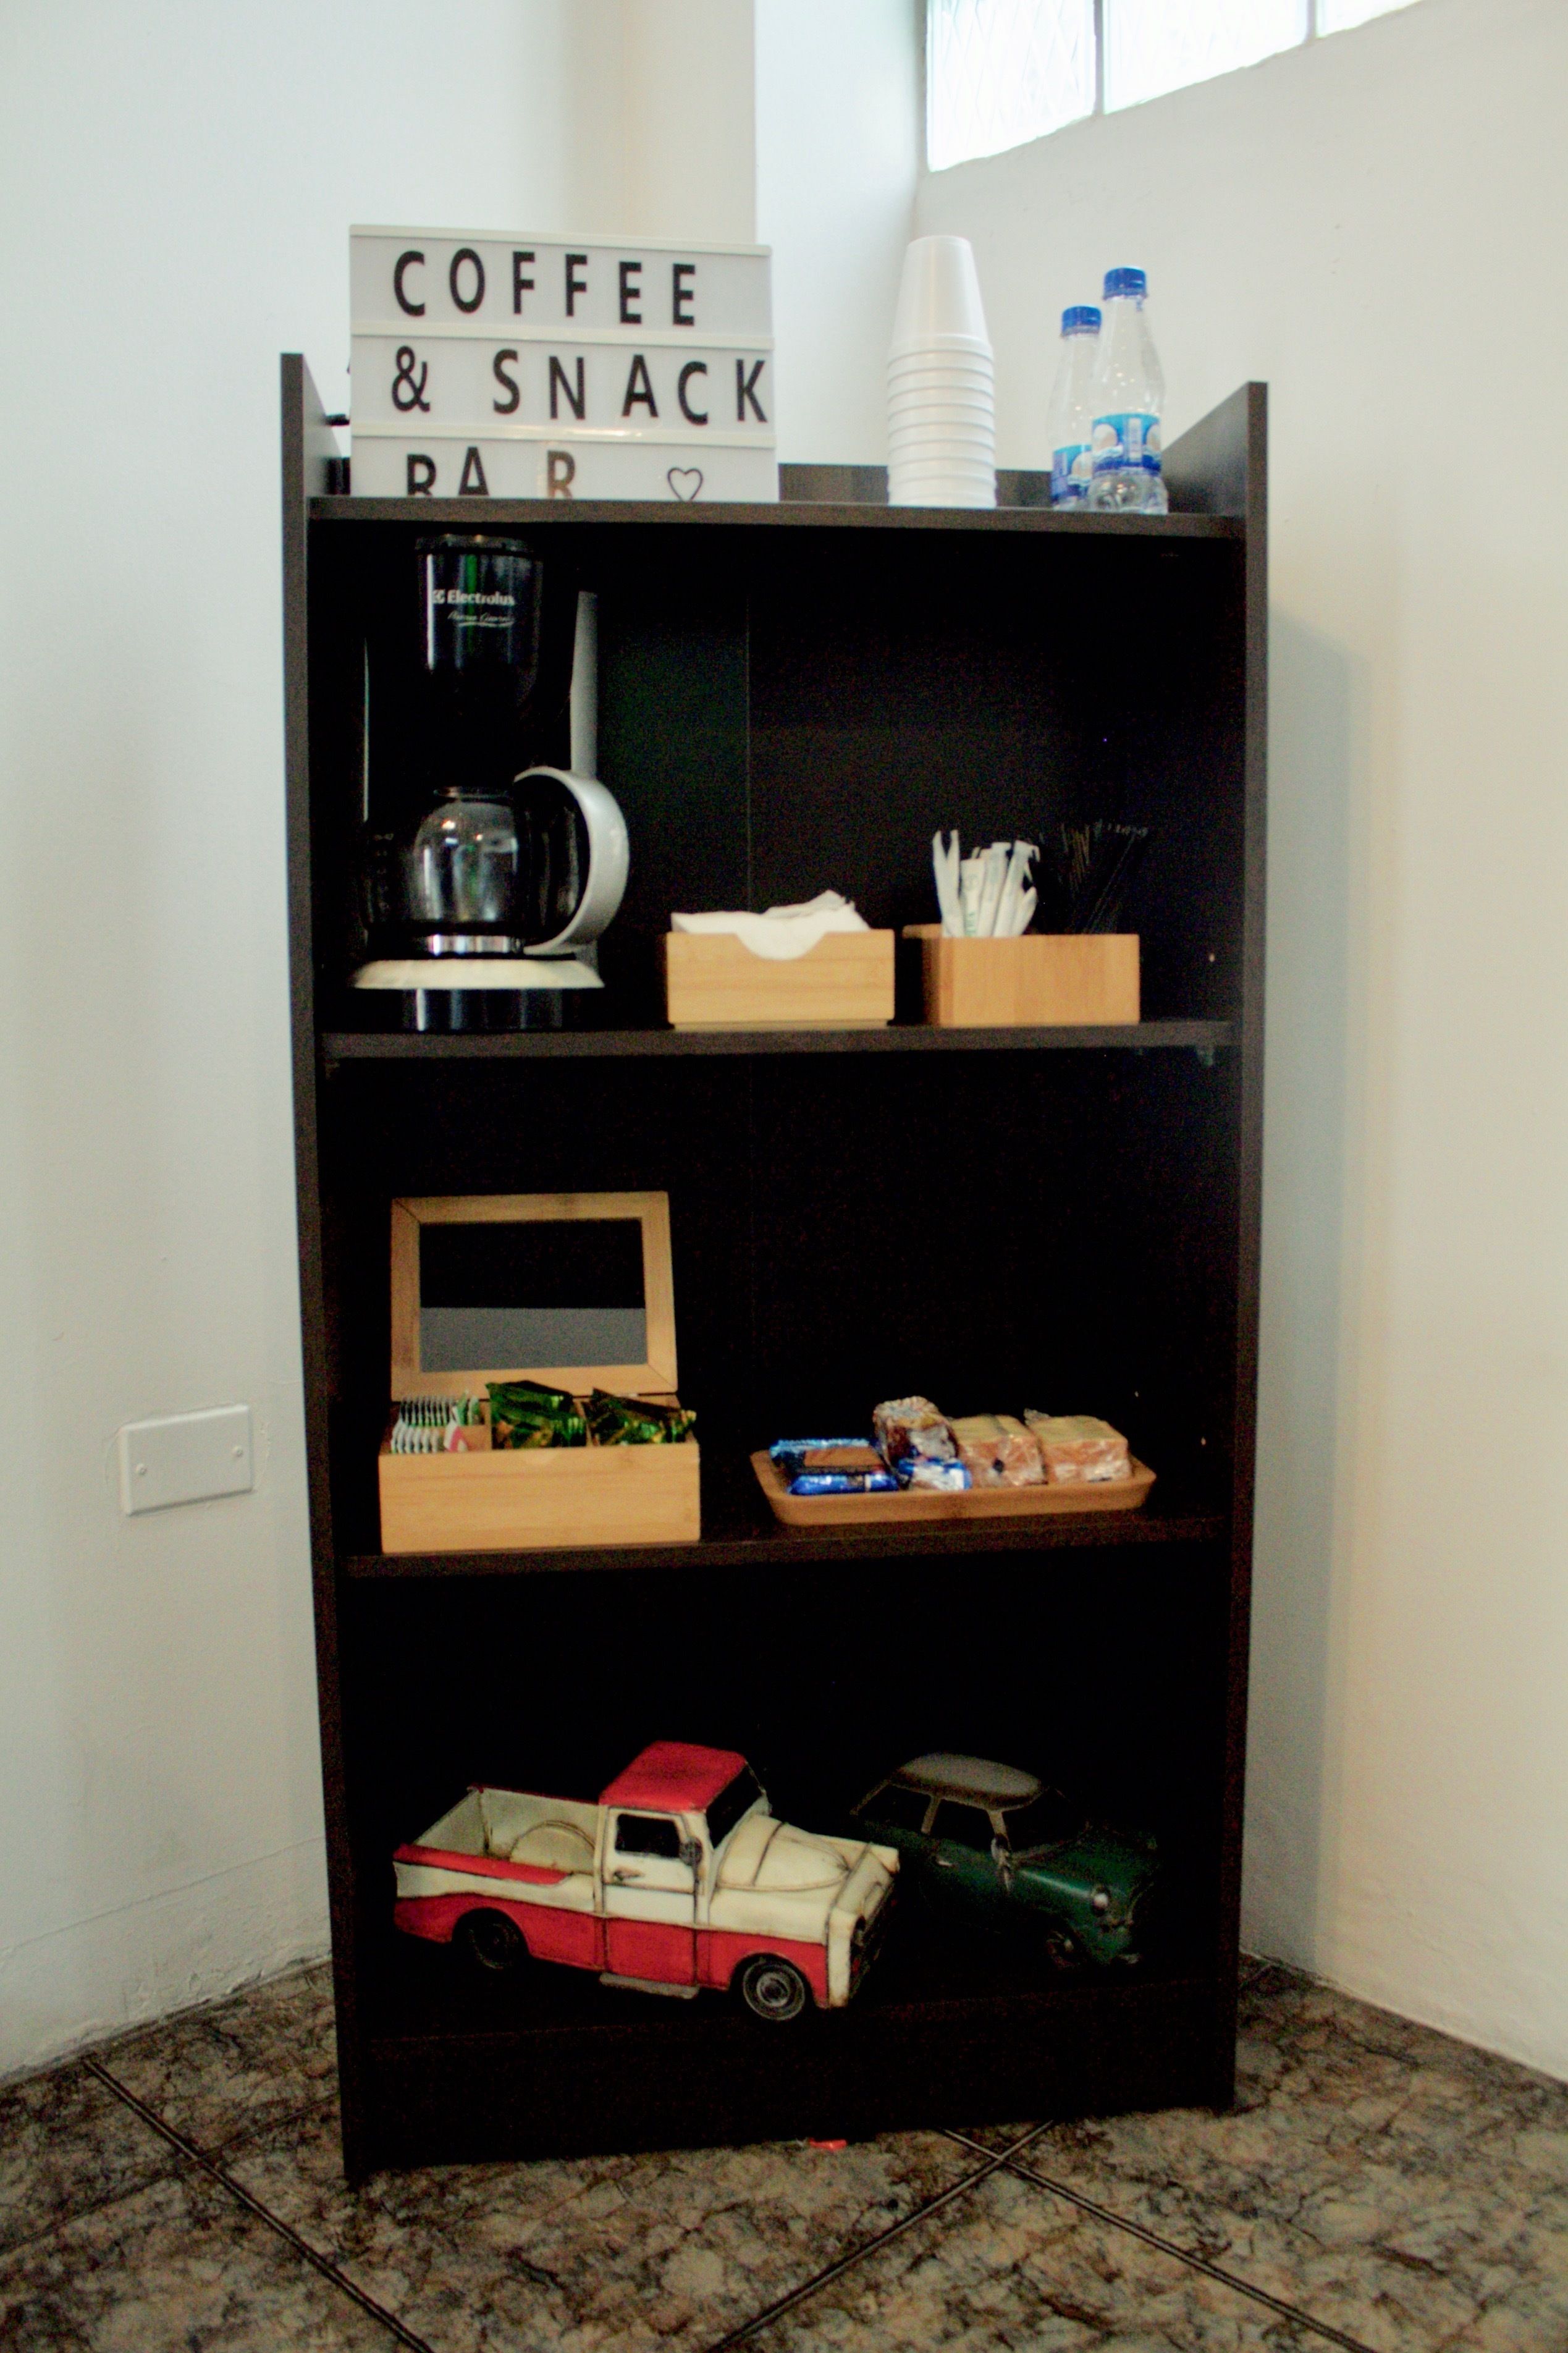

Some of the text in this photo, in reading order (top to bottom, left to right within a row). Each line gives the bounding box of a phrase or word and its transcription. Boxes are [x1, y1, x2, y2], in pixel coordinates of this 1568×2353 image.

[393, 247, 696, 327] COFFEE
[391, 345, 767, 426] & SNACK
[447, 589, 515, 606] Electrolux
